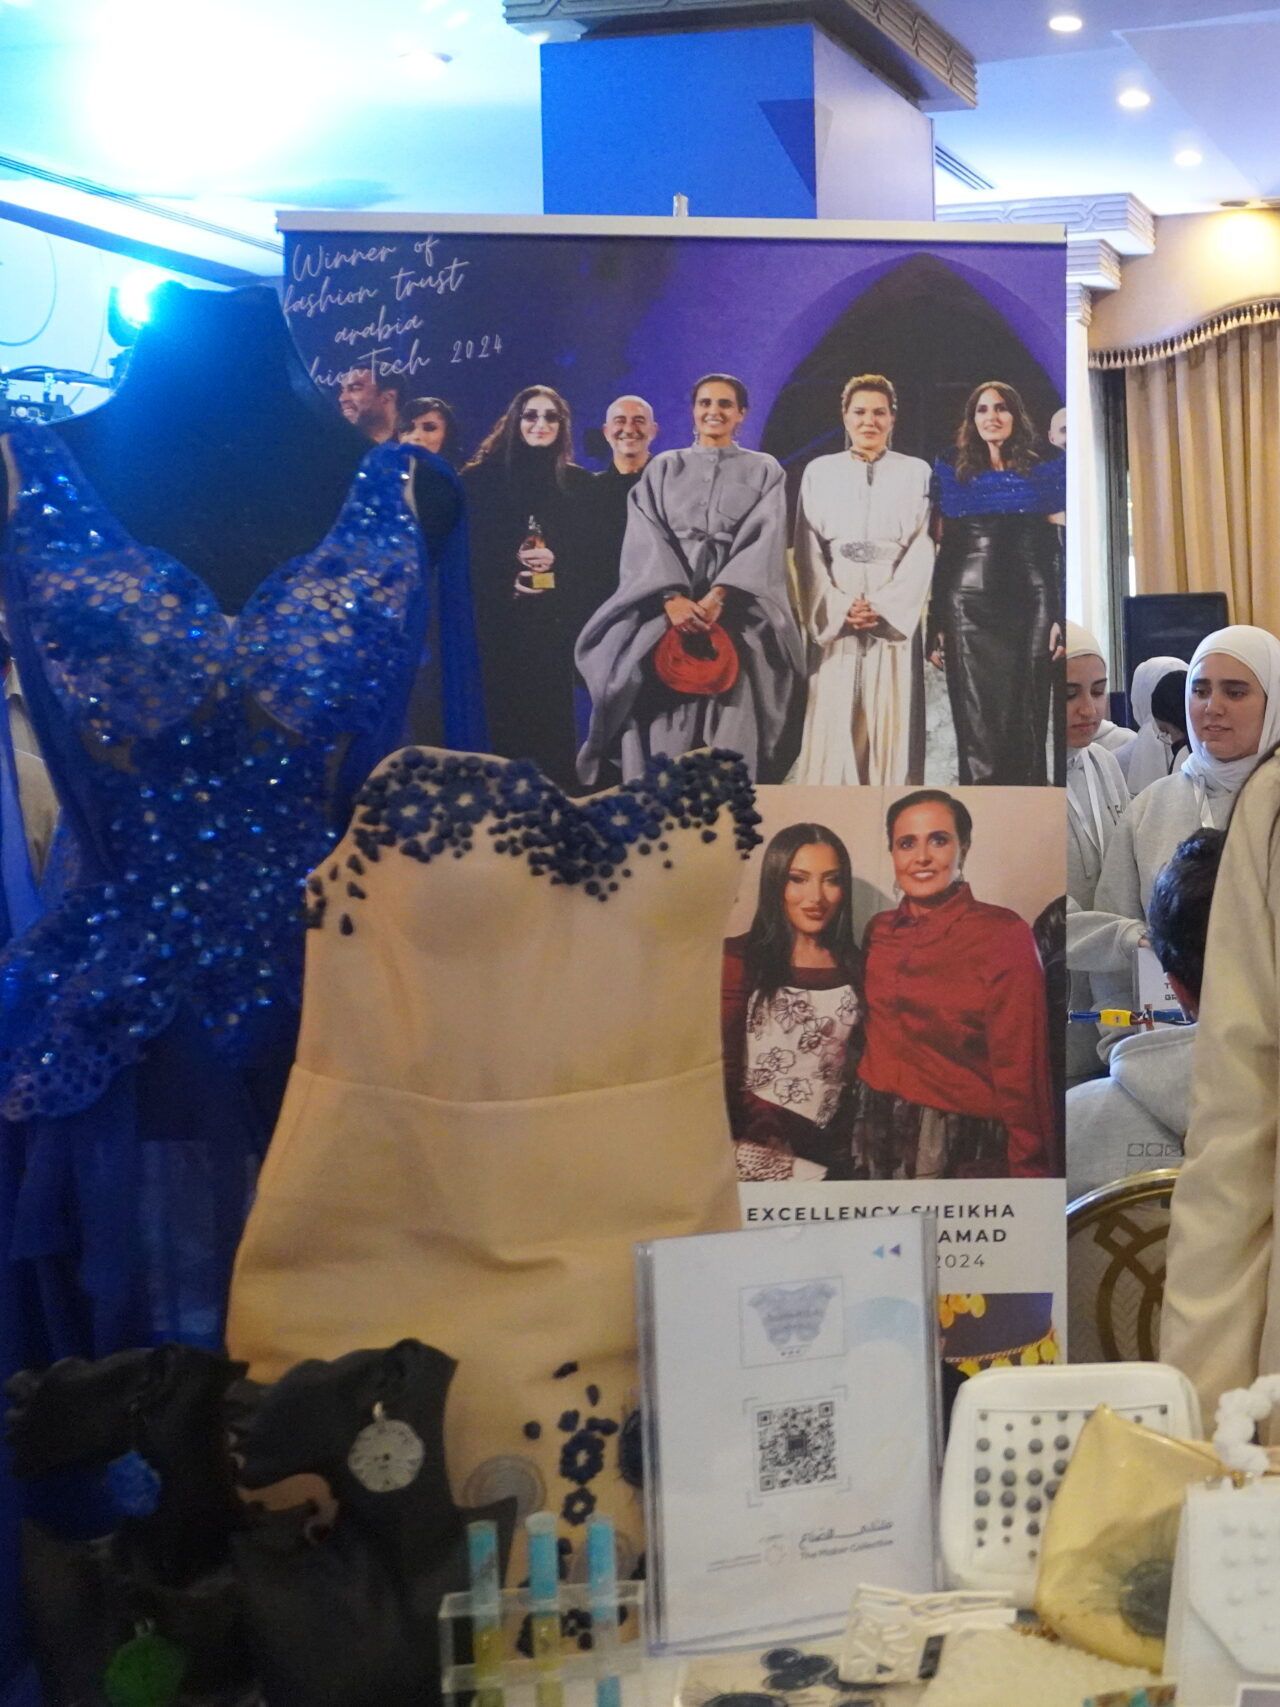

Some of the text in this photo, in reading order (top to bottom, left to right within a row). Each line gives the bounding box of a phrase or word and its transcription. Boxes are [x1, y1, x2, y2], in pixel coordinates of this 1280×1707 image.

[292, 233, 441, 281] Winner of
[284, 257, 470, 318] fashion trust
[334, 305, 423, 346] arabia
[308, 334, 503, 386] hionTech 2024
[747, 1206, 900, 1221] EXCELLENCY
[937, 1229, 1007, 1243] AMAD
